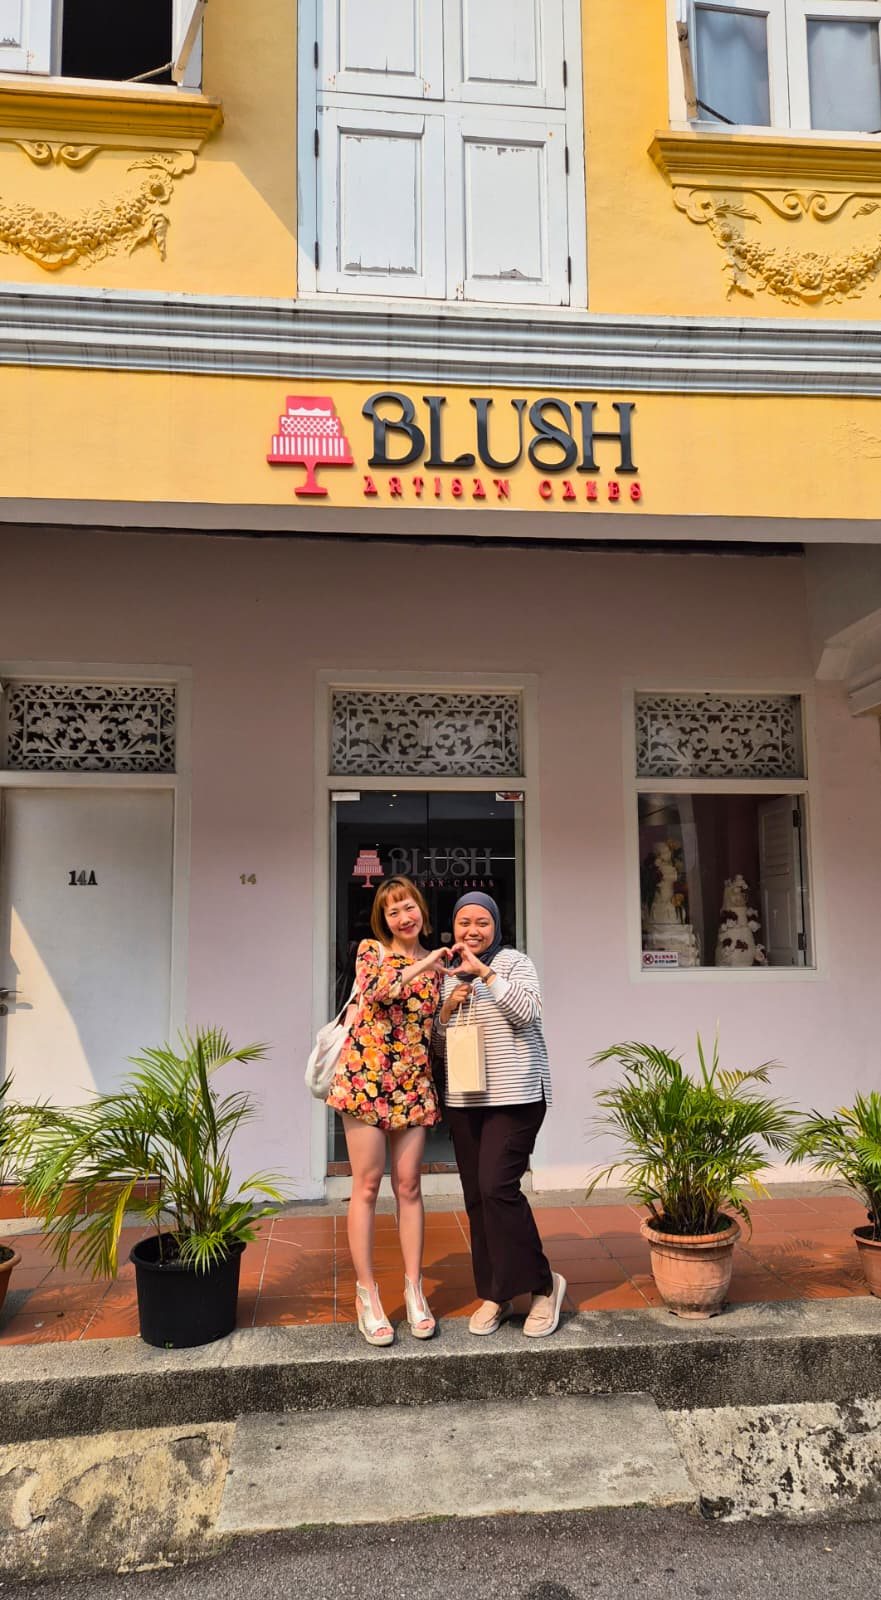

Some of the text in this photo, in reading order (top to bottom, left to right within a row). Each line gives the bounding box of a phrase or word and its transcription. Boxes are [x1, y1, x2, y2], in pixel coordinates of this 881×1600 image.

[362, 391, 639, 474] BLUSH
[363, 475, 642, 503] ARTISAN CAKES
[388, 848, 493, 877] BLUSH
[68, 870, 98, 886] 14A
[239, 873, 257, 885] 14
